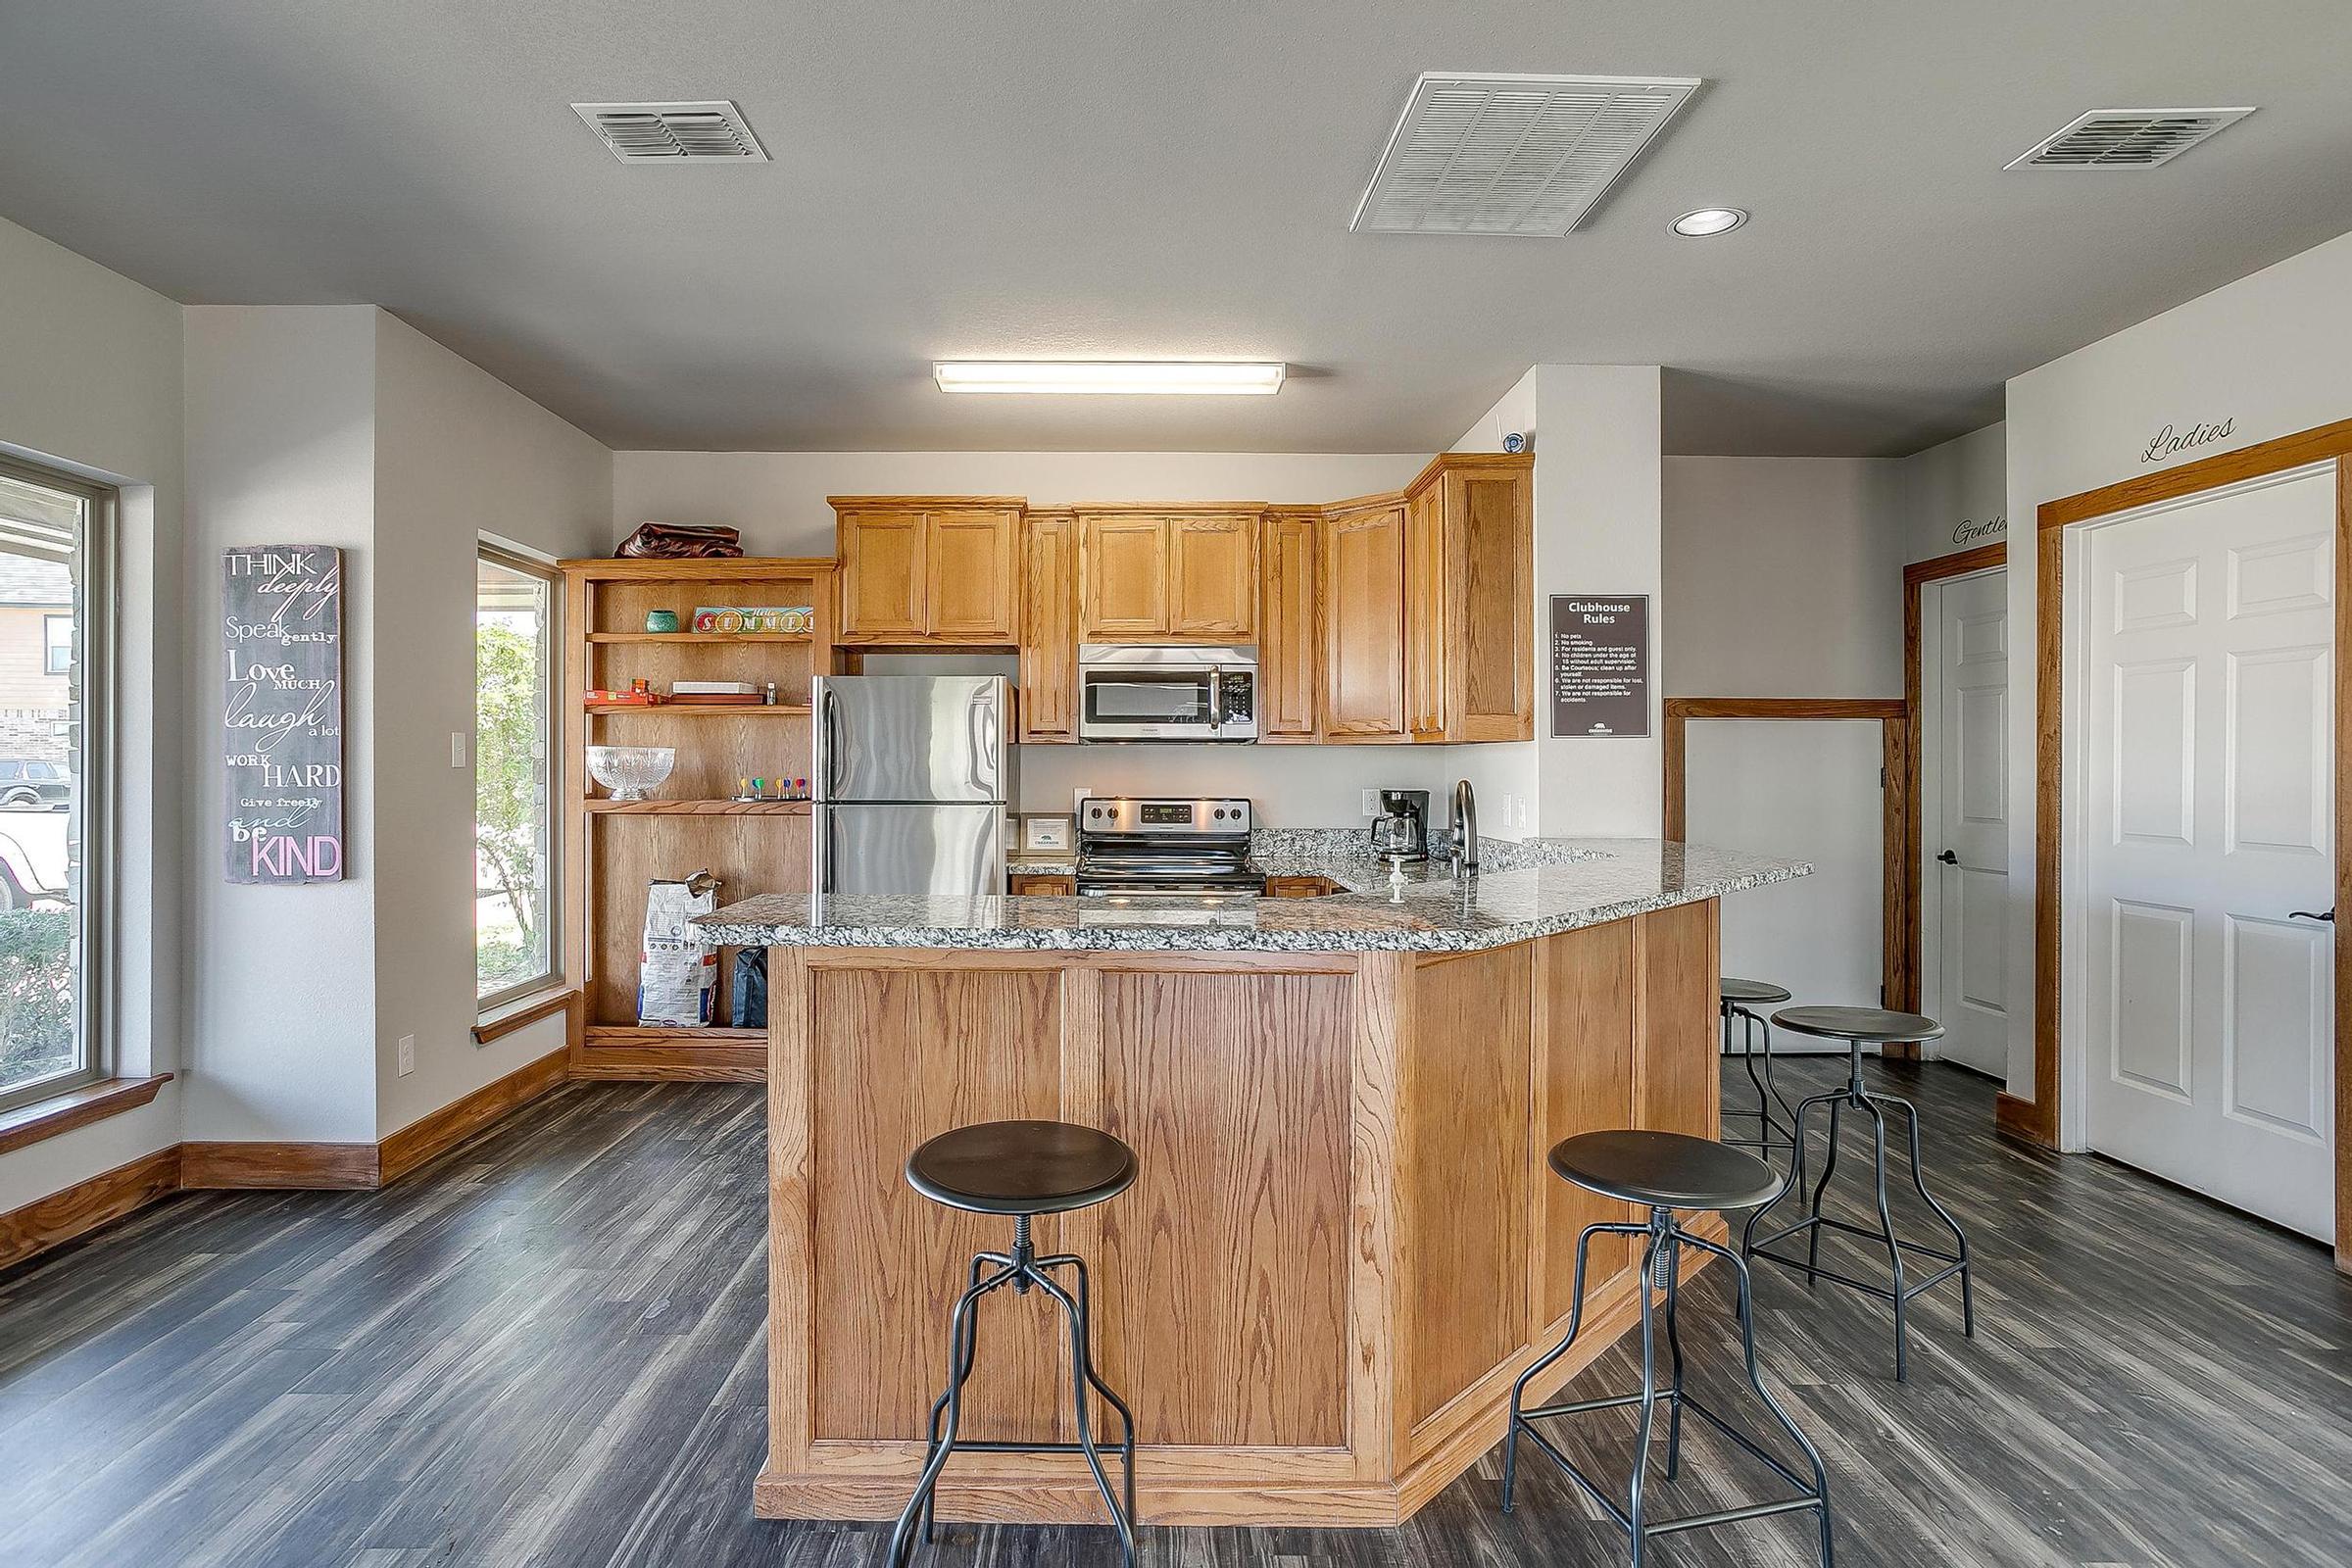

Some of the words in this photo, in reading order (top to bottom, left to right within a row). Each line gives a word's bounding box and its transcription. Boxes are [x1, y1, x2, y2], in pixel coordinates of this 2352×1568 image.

[2140, 416, 2236, 463] Ladies
[1952, 515, 2007, 545] Gentle
[222, 553, 318, 575] THINK
[257, 563, 338, 622] deeply
[1568, 602, 1630, 612] Clubhouse
[1583, 613, 1616, 624] Rules
[225, 615, 290, 643] Speak
[281, 632, 338, 646] gently
[227, 649, 295, 682] Love
[273, 680, 320, 690] MUCH
[225, 680, 335, 752] laugh
[321, 725, 340, 736] lot
[225, 755, 271, 766] WORK
[263, 764, 340, 788] HARD
[228, 798, 321, 829] and
[240, 798, 272, 808] Give
[275, 798, 322, 809] freely
[232, 824, 268, 842] be
[252, 835, 340, 876] KIND
